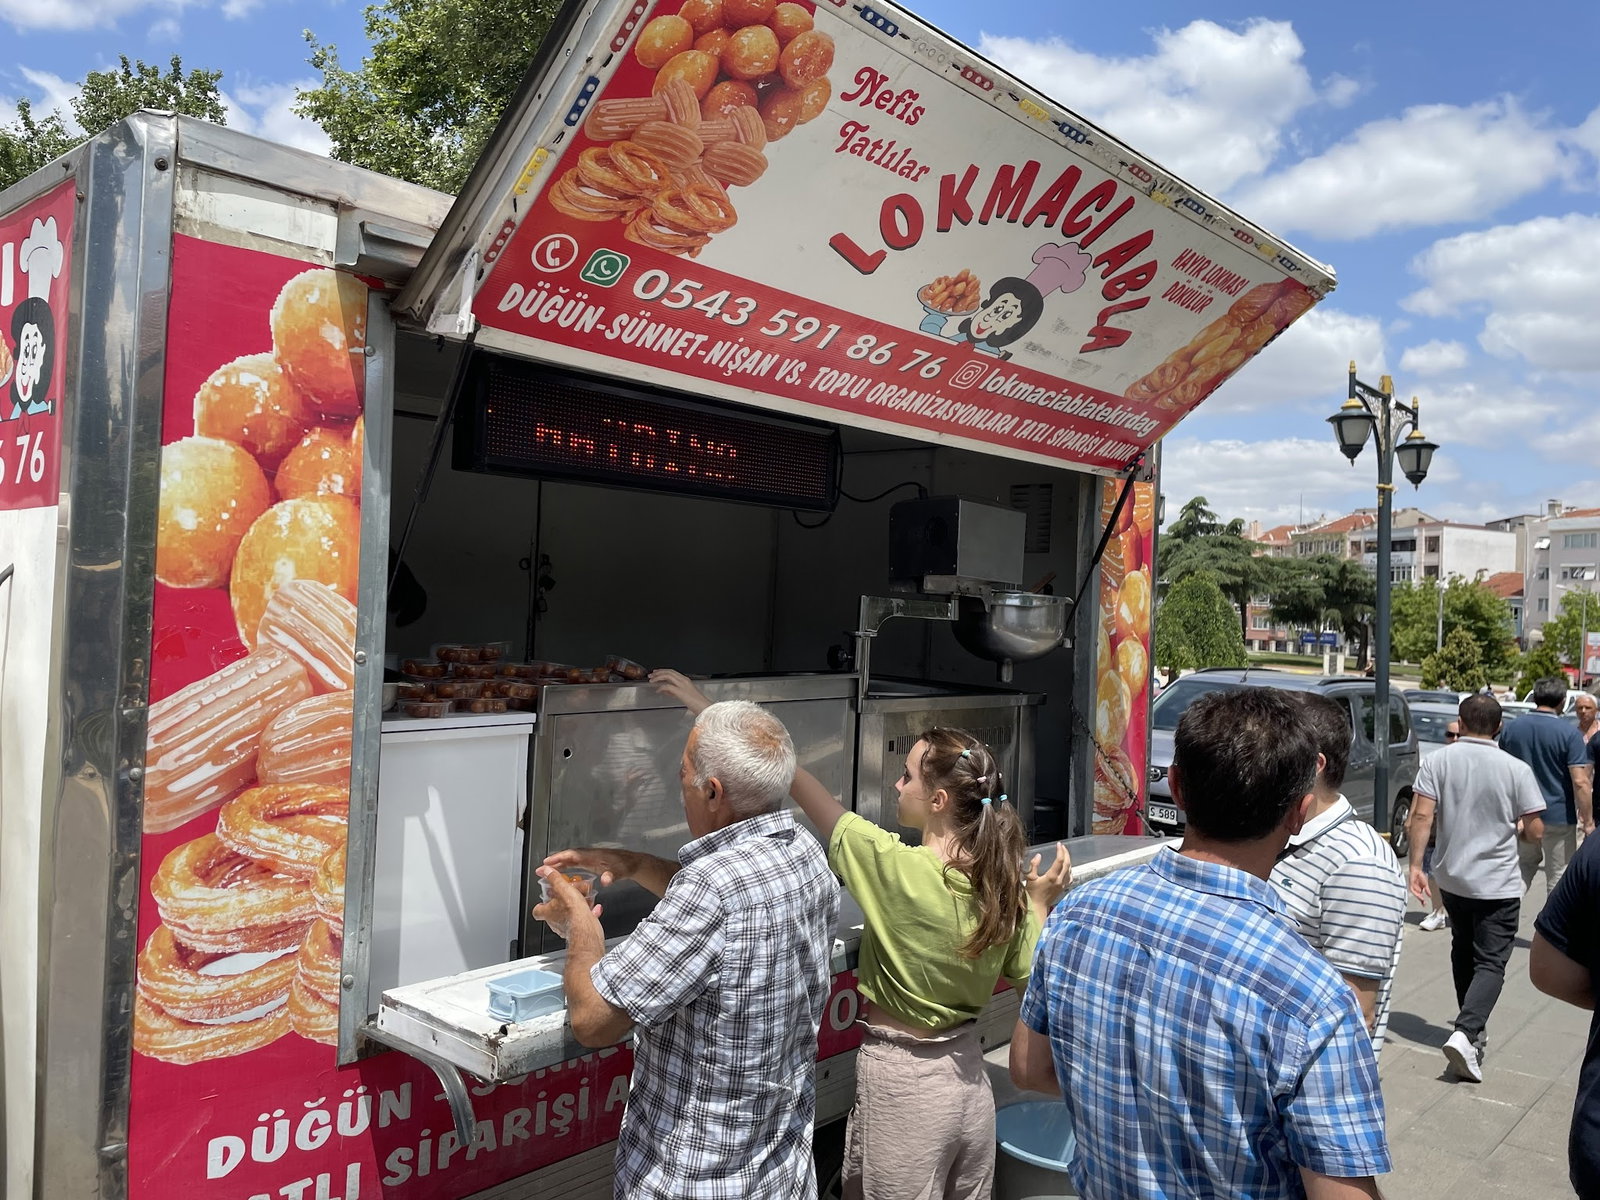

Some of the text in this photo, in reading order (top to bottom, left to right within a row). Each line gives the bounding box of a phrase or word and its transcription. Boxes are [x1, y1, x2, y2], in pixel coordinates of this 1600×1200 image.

[840, 66, 926, 127] Nefis
[834, 120, 931, 184] Tatlılar
[829, 159, 1159, 354] LOKMACI ABLA
[1171, 248, 1250, 298] HAYIR LOKMASI
[632, 269, 947, 379] 0543 591 86 76
[1161, 279, 1214, 315] DÖKÜLÜR
[497, 281, 1139, 462] DÜĞÜN-SÜNNET-NİŞAN VS. TOPLU ORGANİZASYONLARA TATLI SİPARİŞİ ALINIR
[978, 368, 1160, 438] lokmaciablatekirdag
[15, 431, 45, 484] 76
[1159, 809, 1176, 821] 589
[207, 1081, 412, 1180] DÜĞÜN
[382, 1077, 590, 1187] SİPARİŞİ
